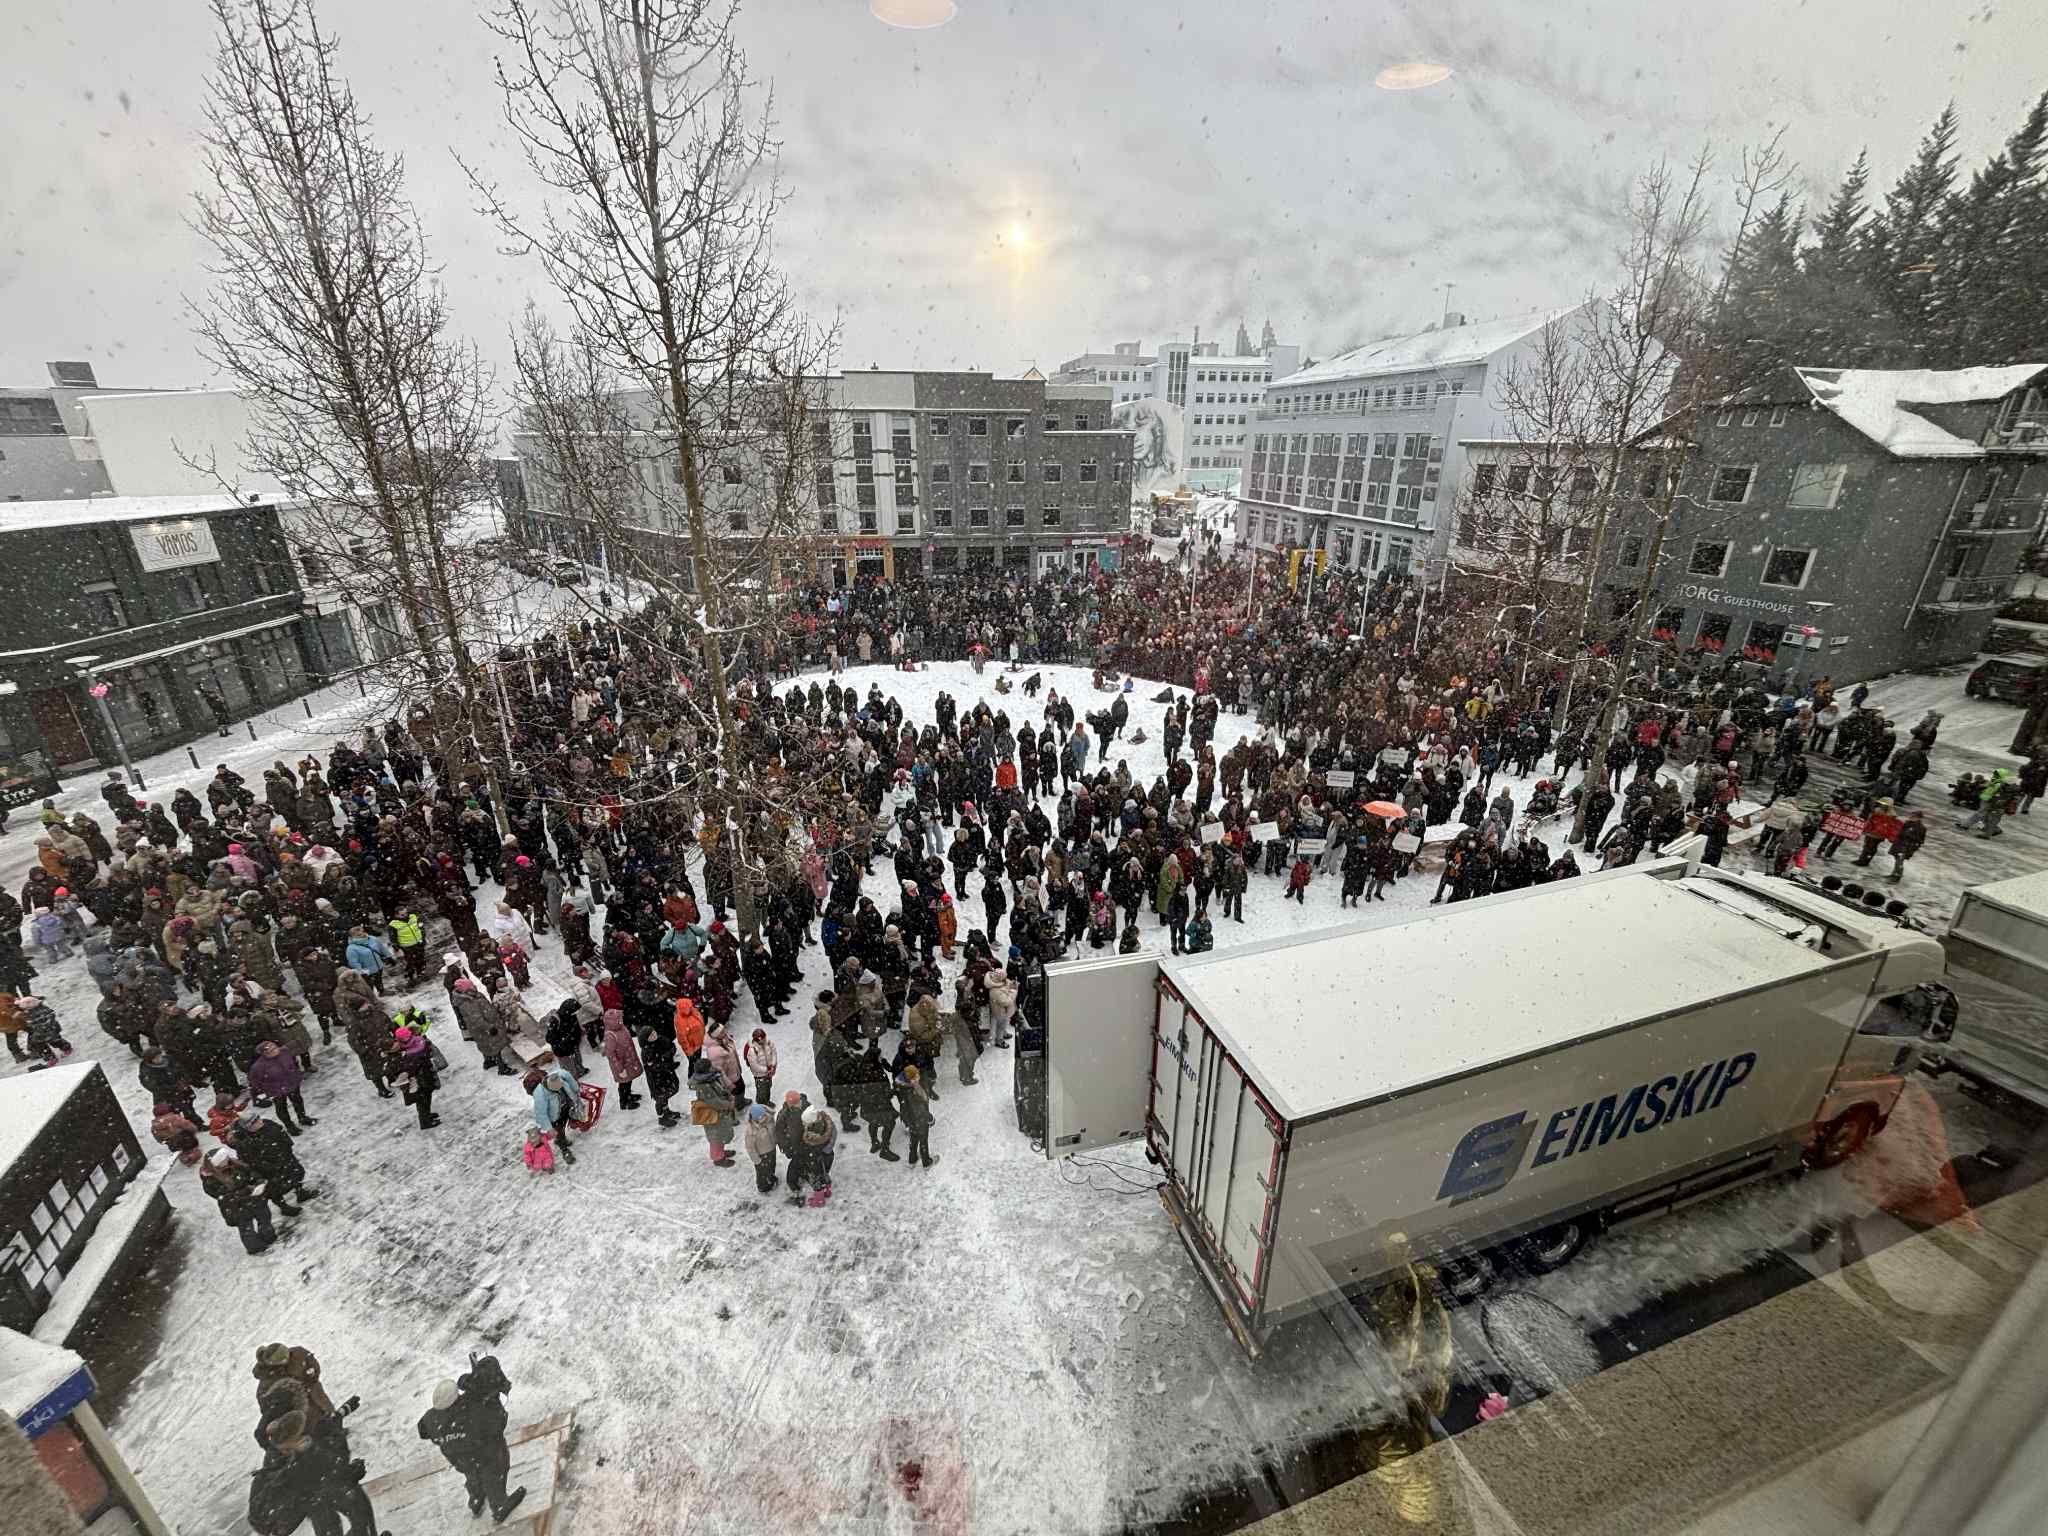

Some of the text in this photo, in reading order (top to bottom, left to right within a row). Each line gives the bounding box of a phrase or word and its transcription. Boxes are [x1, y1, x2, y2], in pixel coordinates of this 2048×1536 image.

[155, 532, 198, 556] VAMOS
[1676, 584, 1794, 614] TORG GUESTHOUSE
[1531, 1051, 1757, 1169] EIMSKIP
